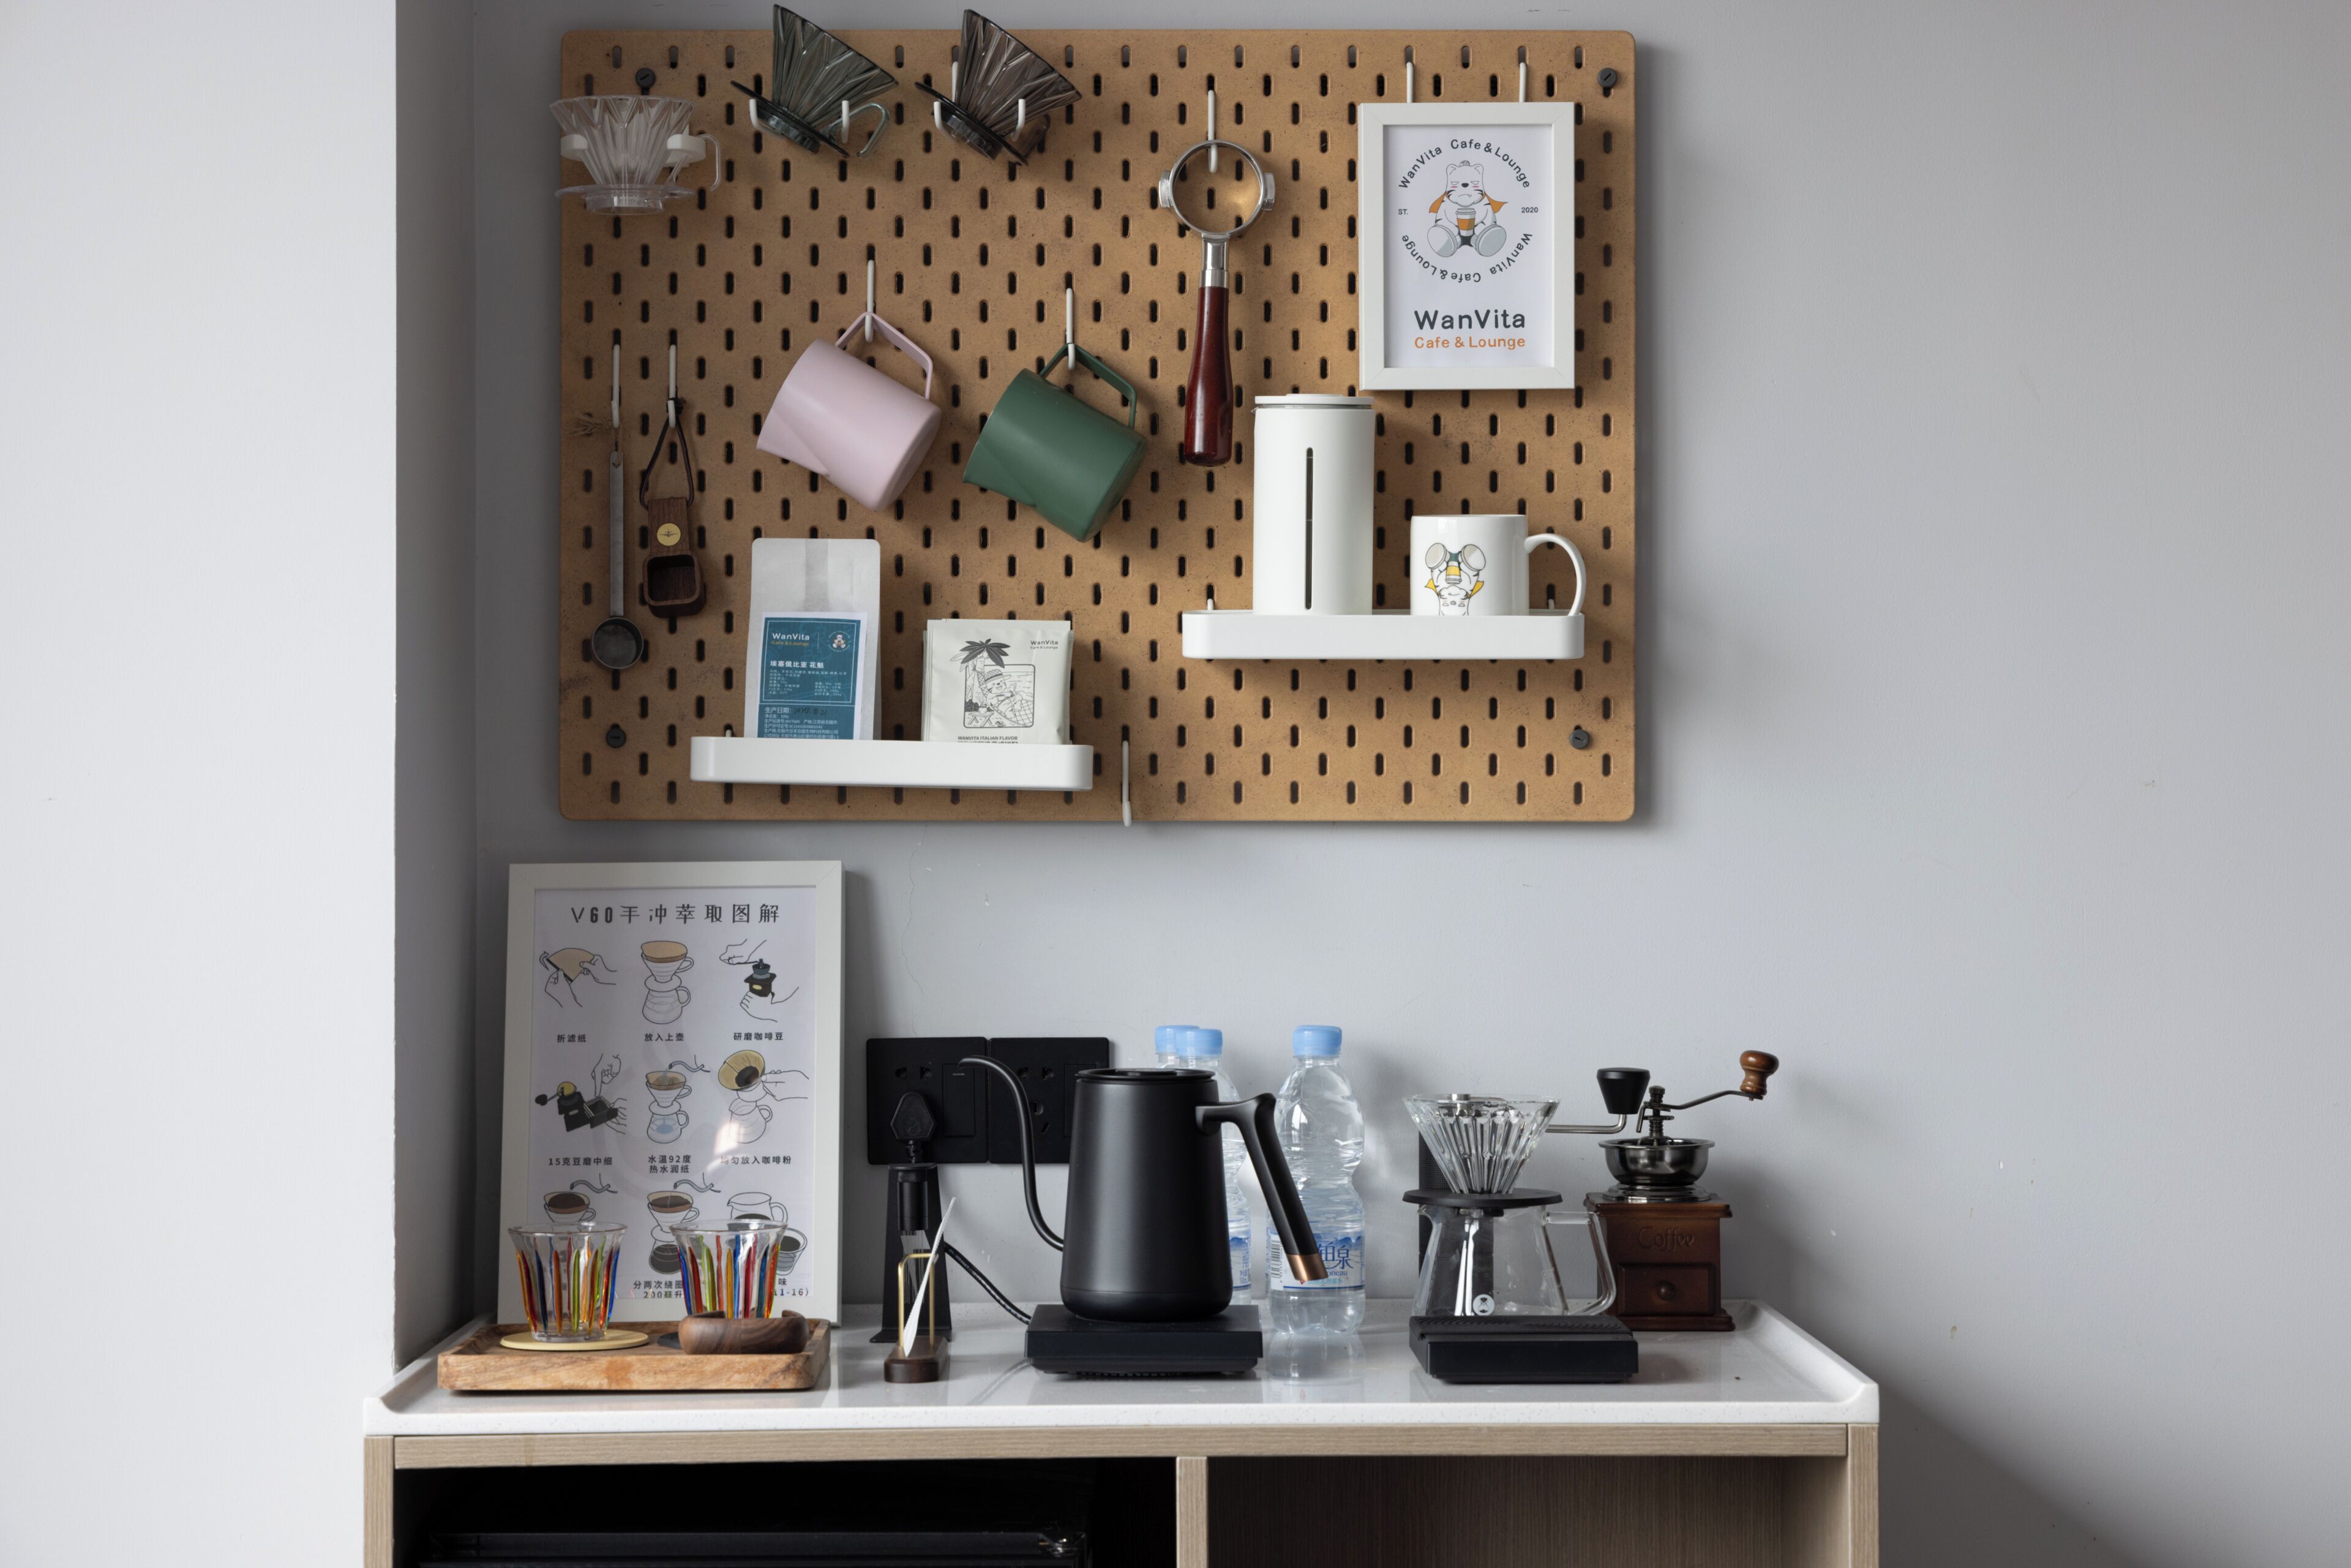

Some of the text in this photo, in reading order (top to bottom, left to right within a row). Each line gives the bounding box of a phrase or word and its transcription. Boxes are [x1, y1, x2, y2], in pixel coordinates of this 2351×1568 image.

[1398, 146, 1442, 189] WanVita
[1489, 233, 1532, 275] WanVita
[1414, 309, 1526, 330] WanVita
[1414, 336, 1526, 350] Cafe & Lounge
[557, 1033, 587, 1043] 折滤纸
[644, 1033, 684, 1042] 放入上壶
[733, 1032, 784, 1042] 研磨咖啡豆
[549, 1157, 613, 1166] 15克豆磨中细
[648, 1154, 691, 1164] 水温92度
[720, 1155, 792, 1165] 均匀放入咖啡粉
[649, 1165, 690, 1174] 热水润纸
[1638, 1226, 1695, 1252] Coffee
